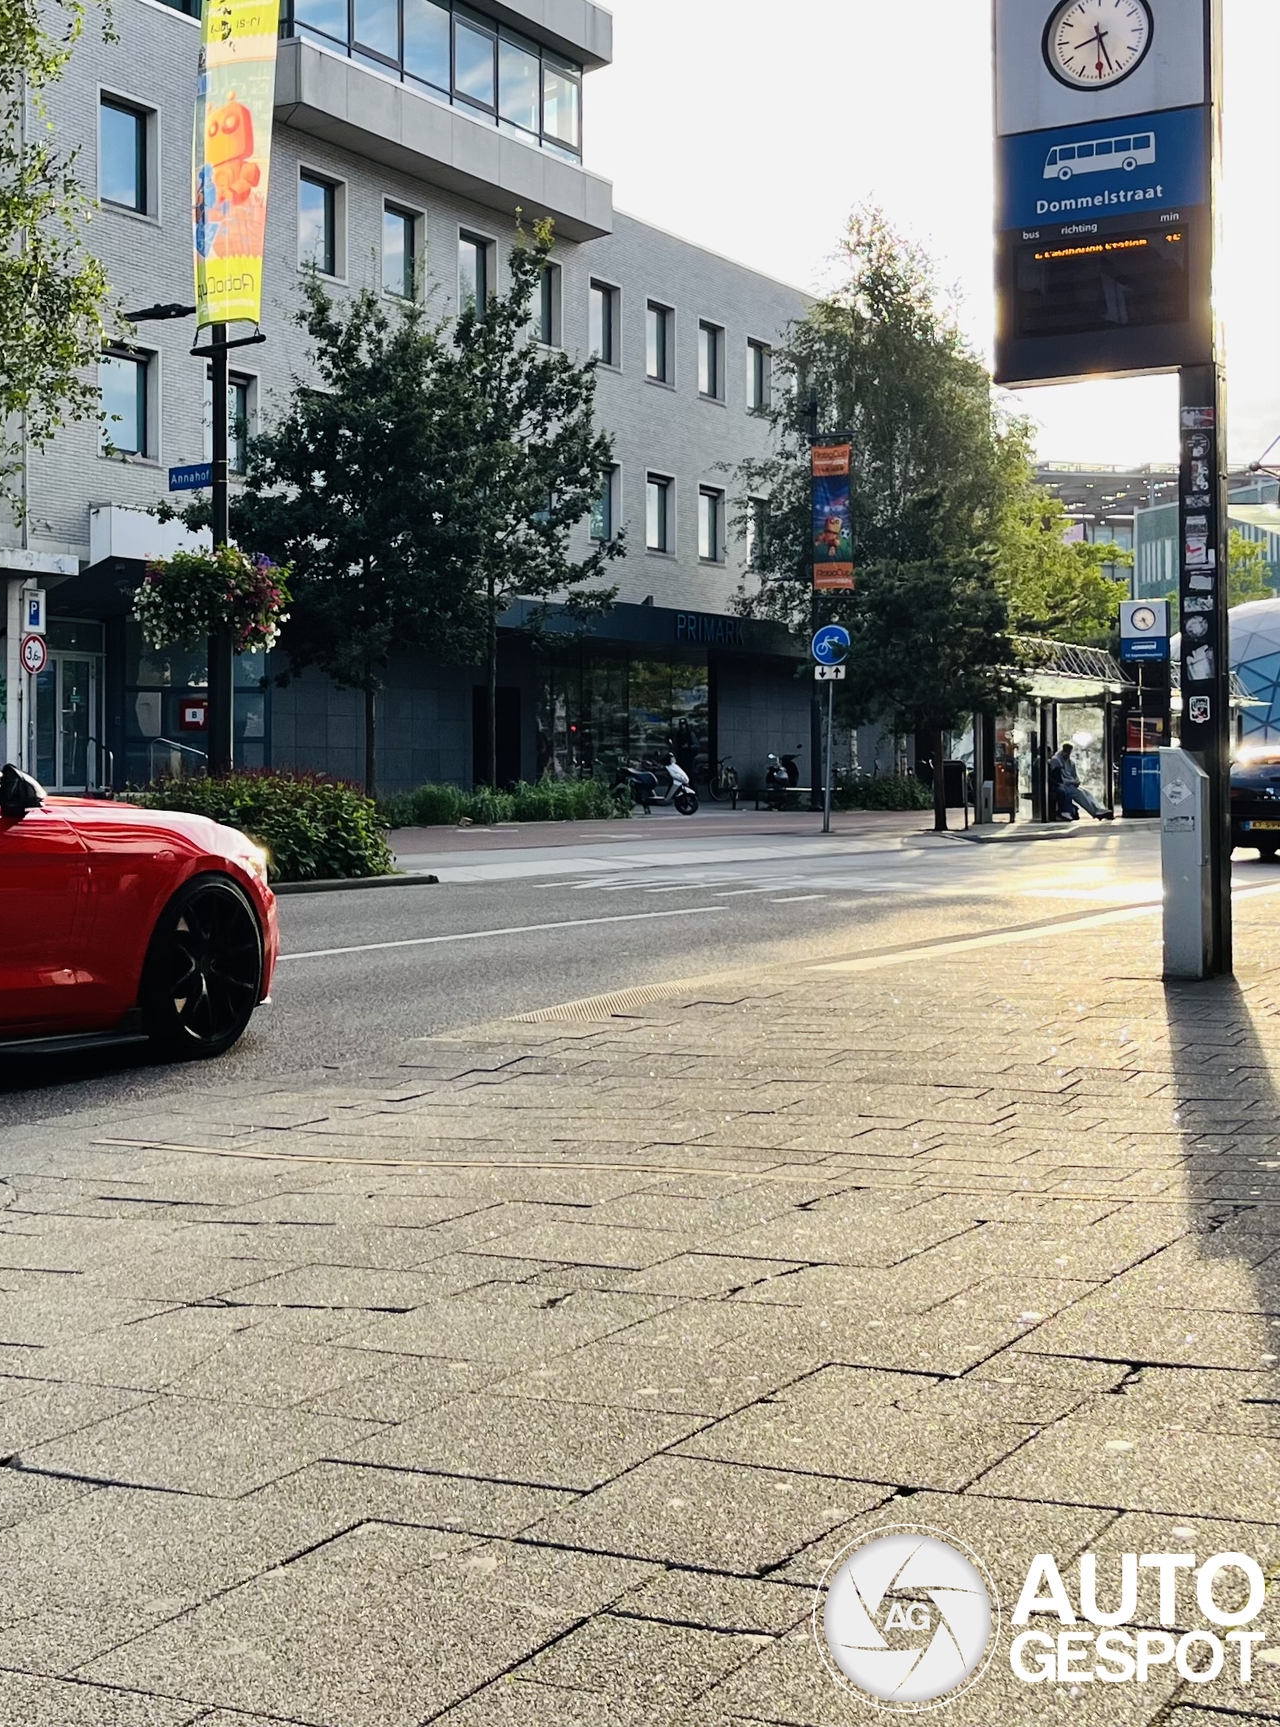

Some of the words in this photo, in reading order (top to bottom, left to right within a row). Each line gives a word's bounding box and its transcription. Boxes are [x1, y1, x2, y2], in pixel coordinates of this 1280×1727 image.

[1036, 184, 1163, 214] Dommelstraat
[1022, 231, 1040, 240] bus
[1061, 223, 1098, 235] richting
[1160, 212, 1179, 222] min
[171, 470, 209, 484] Annahof
[30, 601, 38, 615] P
[677, 614, 745, 645] PRIMARK
[191, 710, 198, 719] B
